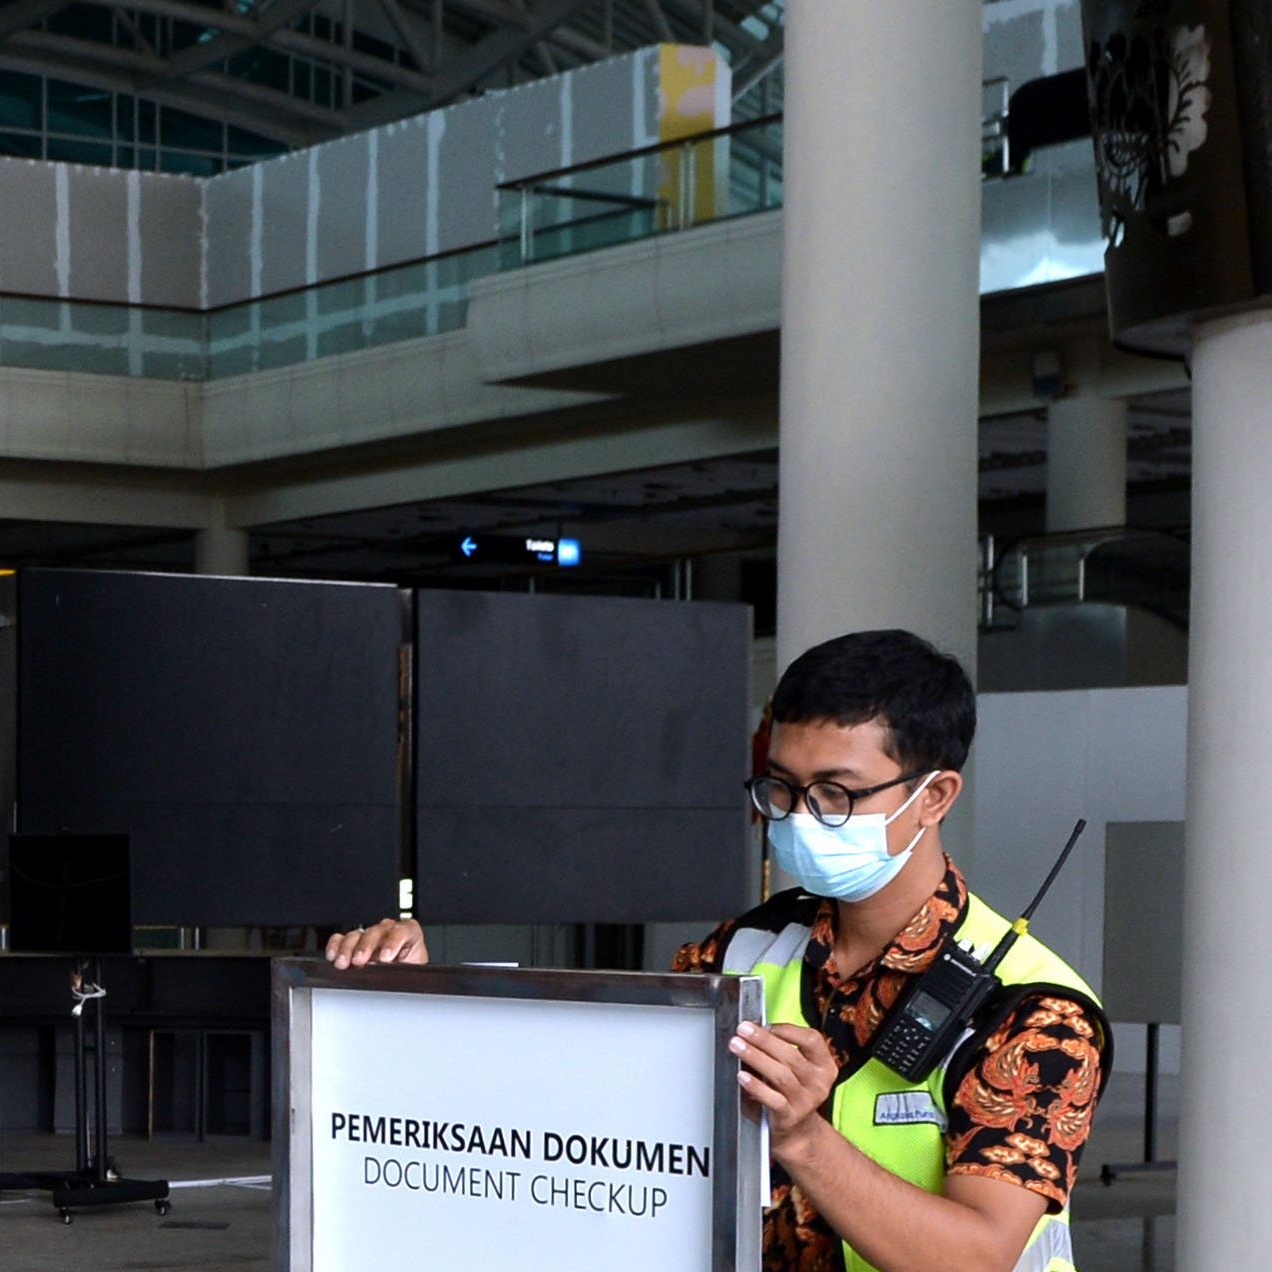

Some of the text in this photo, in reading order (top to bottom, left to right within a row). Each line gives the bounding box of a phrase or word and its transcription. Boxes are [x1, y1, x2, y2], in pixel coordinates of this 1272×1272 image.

[330, 1112, 711, 1178] PEMERIKSAAN DOKUMEN
[363, 1156, 669, 1218] DOCUMENT CHECKUP
